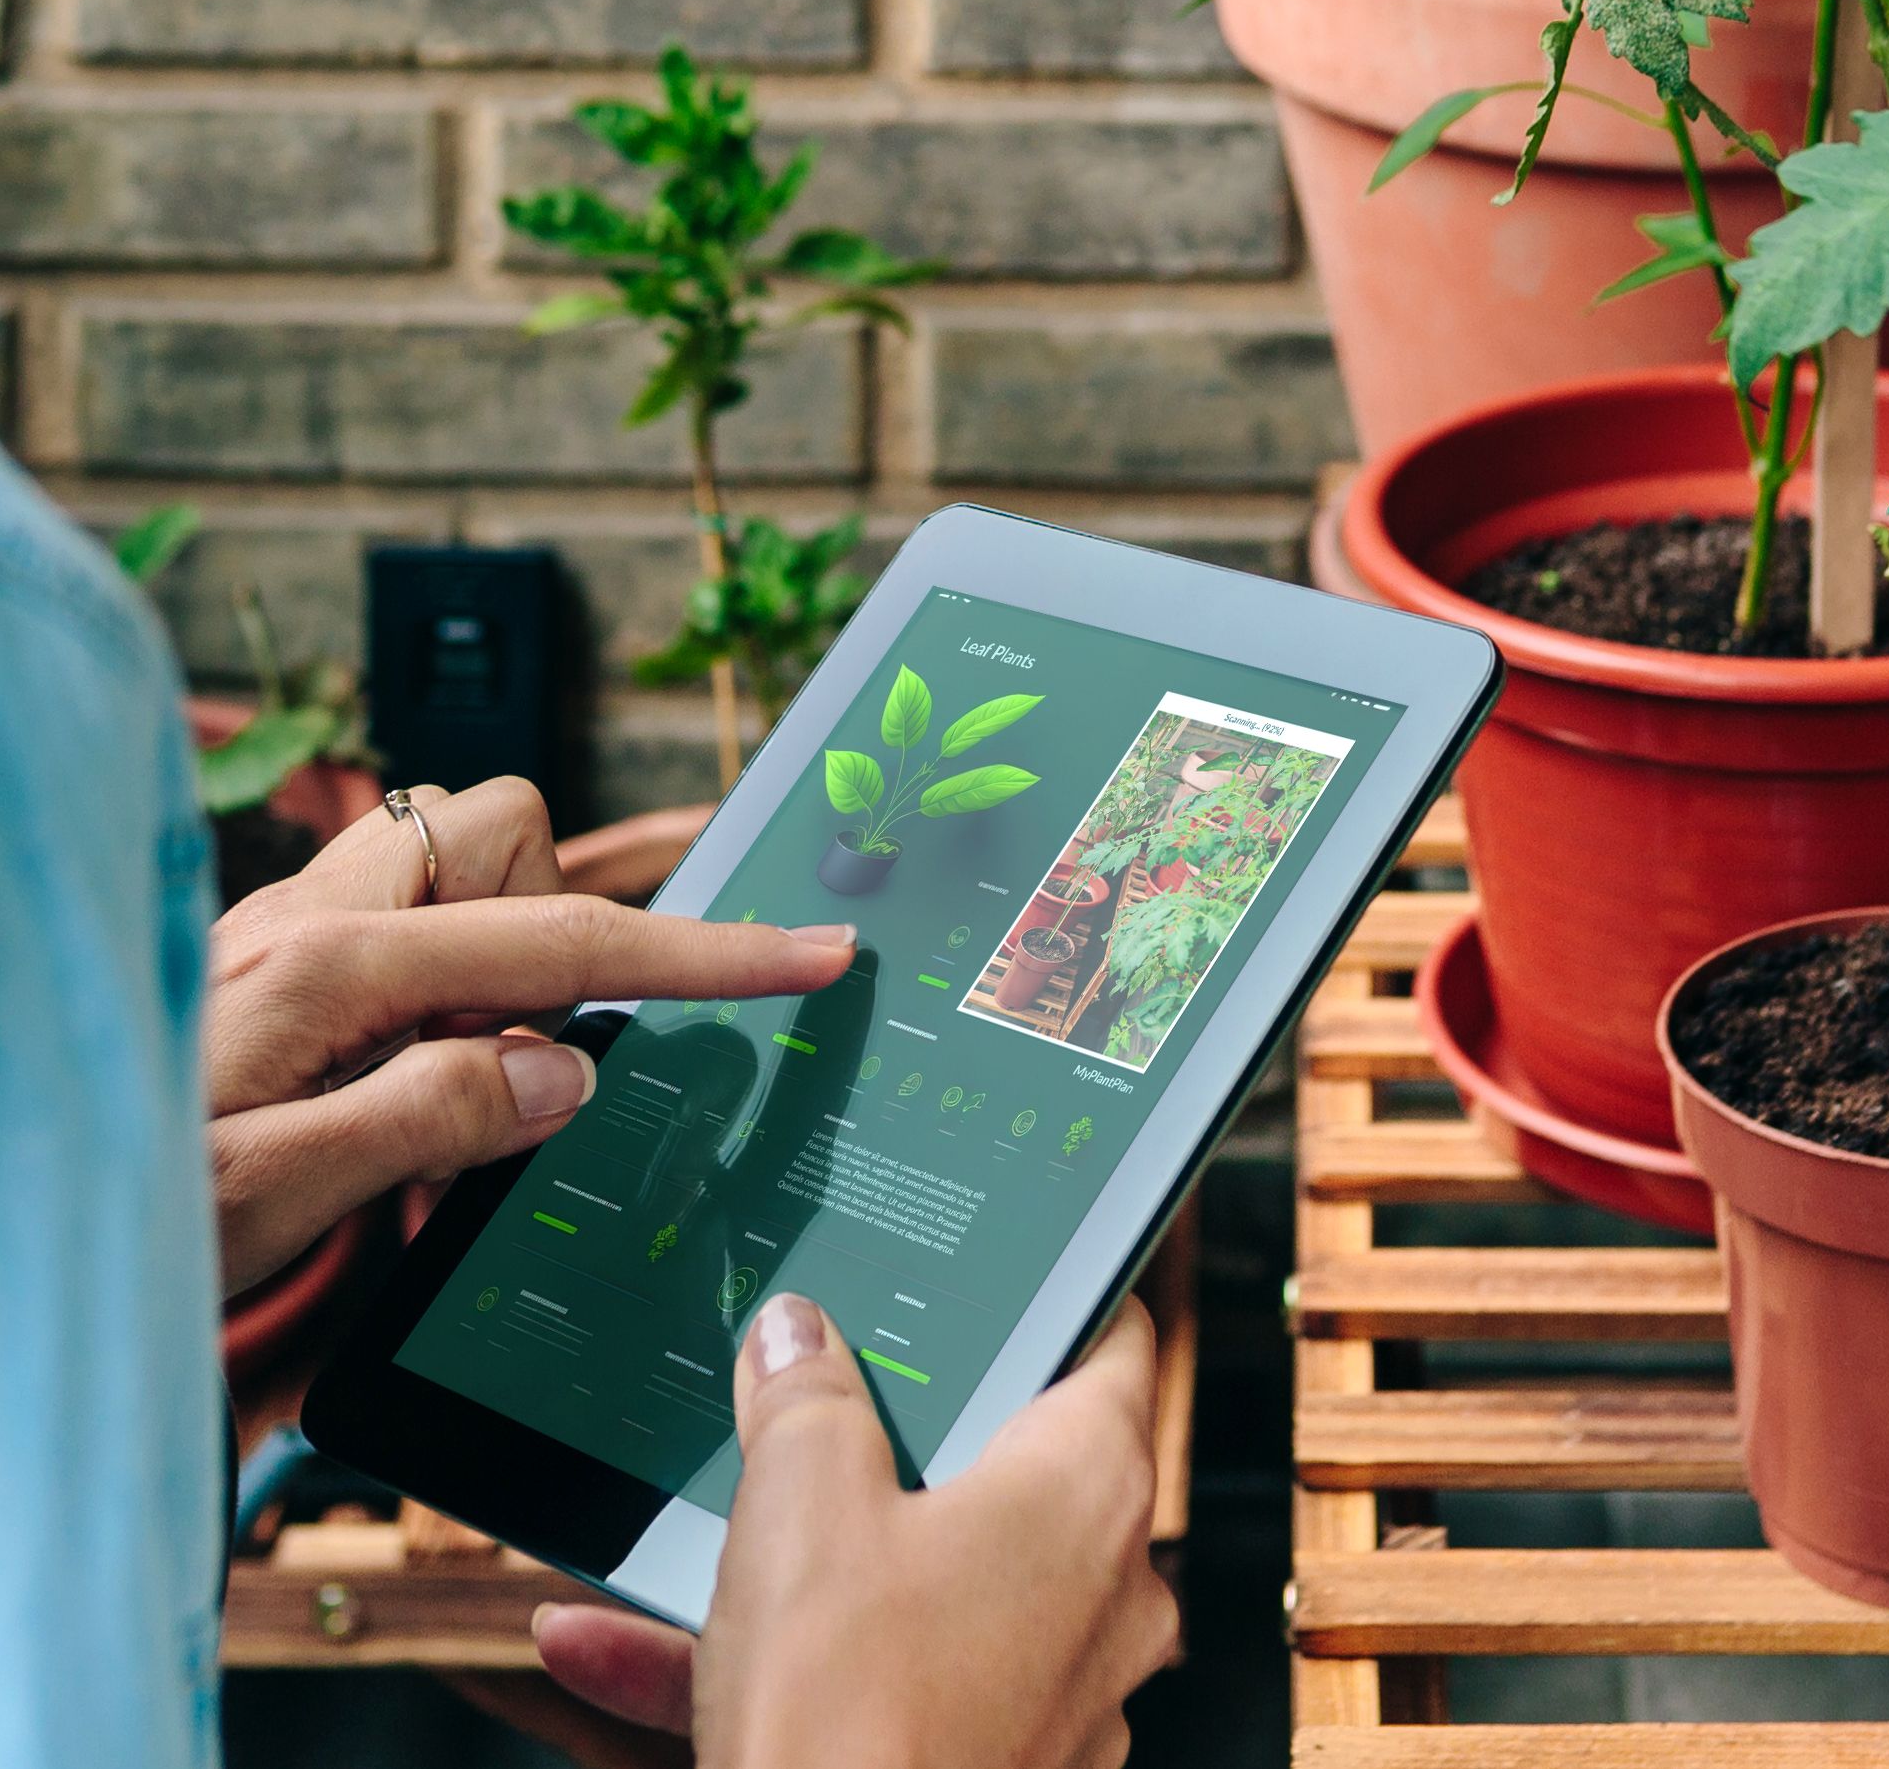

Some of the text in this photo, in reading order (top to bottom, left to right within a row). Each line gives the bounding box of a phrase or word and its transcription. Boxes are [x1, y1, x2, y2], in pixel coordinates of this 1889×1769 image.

[960, 637, 1036, 669] Leaf Plants
[1072, 1065, 1134, 1095] MyPlantPlan
[805, 1139, 825, 1152] Fusce
[824, 1148, 847, 1160] mauris
[895, 1174, 905, 1183] sit
[904, 1179, 923, 1189] amet
[922, 1186, 957, 1203] commodo
[956, 1197, 964, 1205] in
[811, 1129, 833, 1143] Lorem
[853, 1145, 872, 1157] dolor
[870, 1152, 881, 1161] sit
[899, 1164, 940, 1183] consectetur
[938, 1179, 973, 1197] adipiscing
[824, 1159, 832, 1168] in
[894, 1188, 917, 1201] cursus
[916, 1196, 945, 1212] placerat
[944, 1207, 972, 1222] suscipit.
[777, 1180, 804, 1196] Quisque
[804, 1191, 814, 1199] ex
[813, 1195, 835, 1208] sapien
[834, 1202, 865, 1220] interdum
[873, 1218, 897, 1232] viverra
[896, 1228, 905, 1236] at
[904, 1230, 932, 1246] dapibus
[931, 1238, 954, 1255] metus.
[784, 1170, 804, 1183] turpis
[803, 1179, 838, 1196] consequat
[836, 1191, 851, 1201] non
[850, 1195, 869, 1208] lacus
[868, 1204, 884, 1214] quis
[883, 1208, 917, 1227] bibendum
[917, 1223, 940, 1236] cursus
[823, 1173, 834, 1182] sit
[832, 1178, 851, 1188] amet
[887, 1196, 898, 1206] Ut
[904, 1205, 925, 1217] porta
[936, 1215, 967, 1233] Praesent
